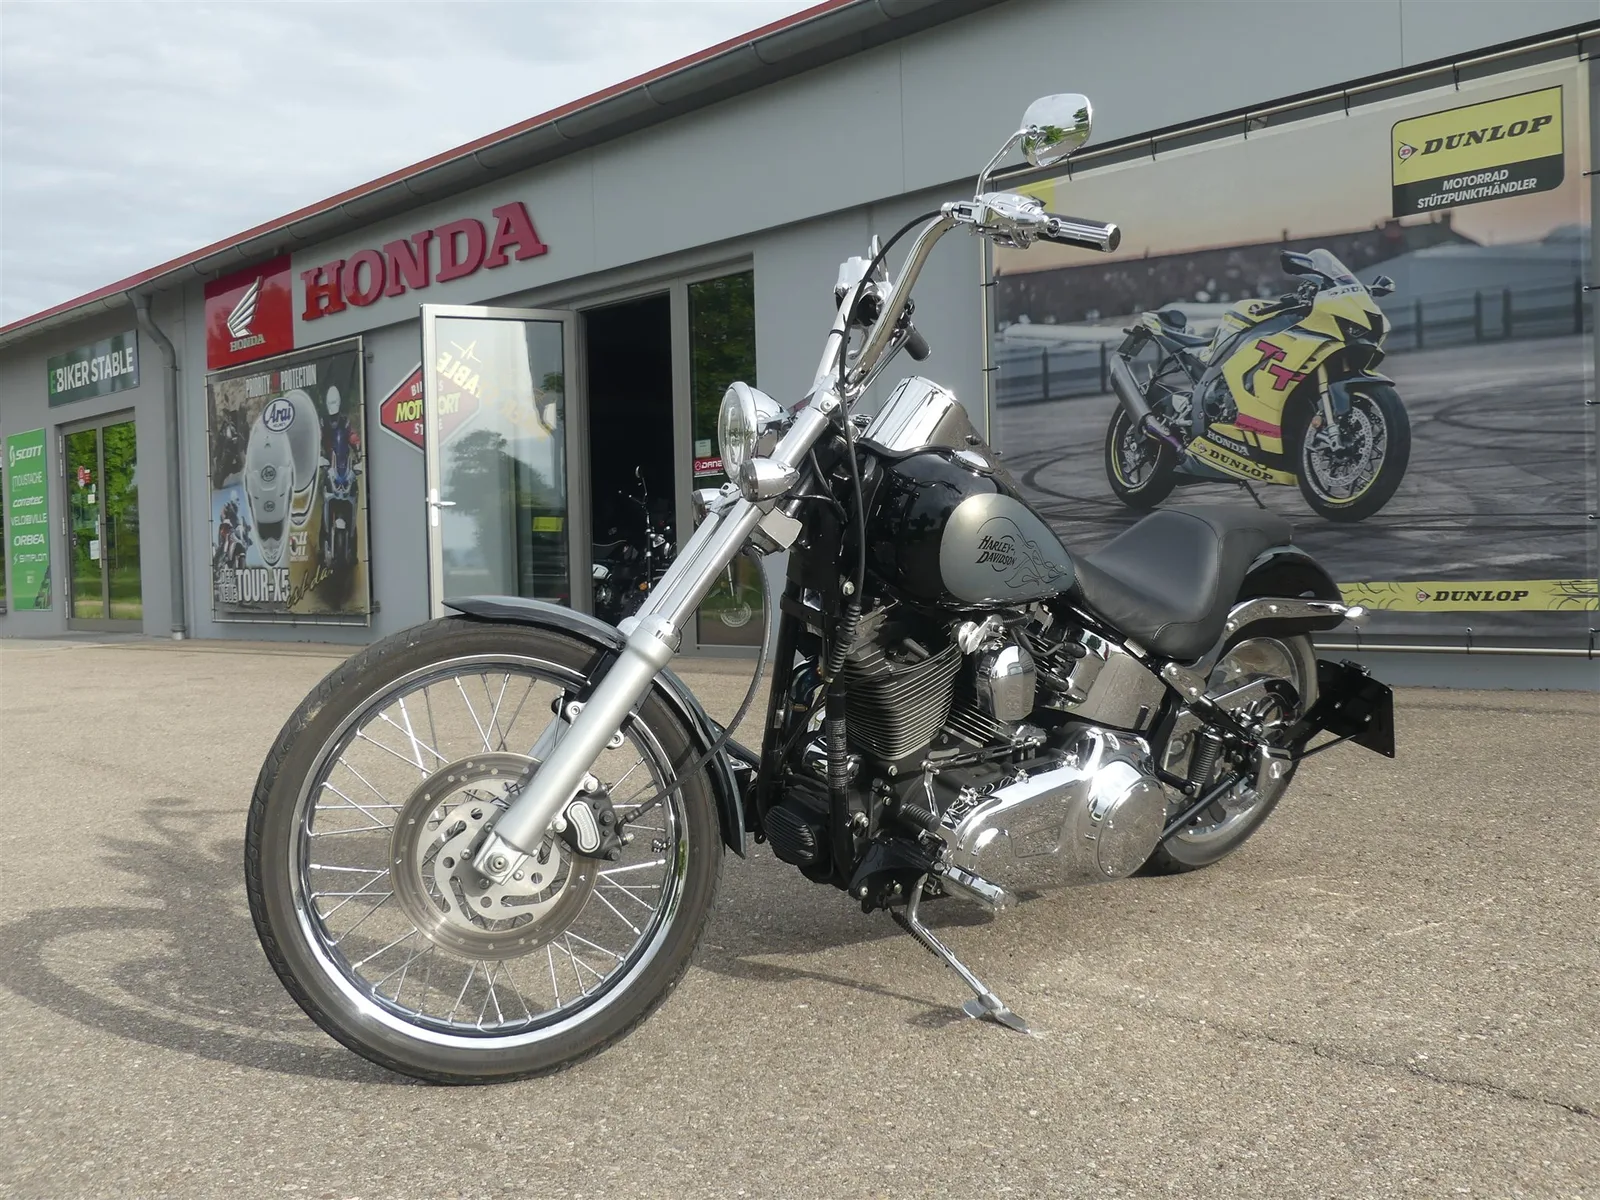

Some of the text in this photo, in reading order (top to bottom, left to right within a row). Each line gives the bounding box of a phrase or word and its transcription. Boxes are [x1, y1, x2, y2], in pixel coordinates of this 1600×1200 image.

[1420, 115, 1553, 156] DUNLOP
[1442, 169, 1509, 191] MOTORRAD
[1417, 177, 1538, 209] STÜTZPUNKTHÄNDLER
[300, 201, 548, 321] HONDA
[230, 334, 266, 352] HONDA
[91, 347, 134, 382] STABLE
[281, 364, 317, 391] PROTECTION
[265, 402, 291, 424] Arai
[414, 419, 443, 435] STE
[16, 445, 43, 460] SCOTT
[1206, 429, 1250, 456] HONDA
[1208, 449, 1274, 480] DUNLOP
[14, 534, 45, 546] ORBEA
[975, 551, 1017, 566] DAVIDSON
[236, 569, 290, 602] TOUR-X5
[1433, 590, 1529, 602] DUNLOP
